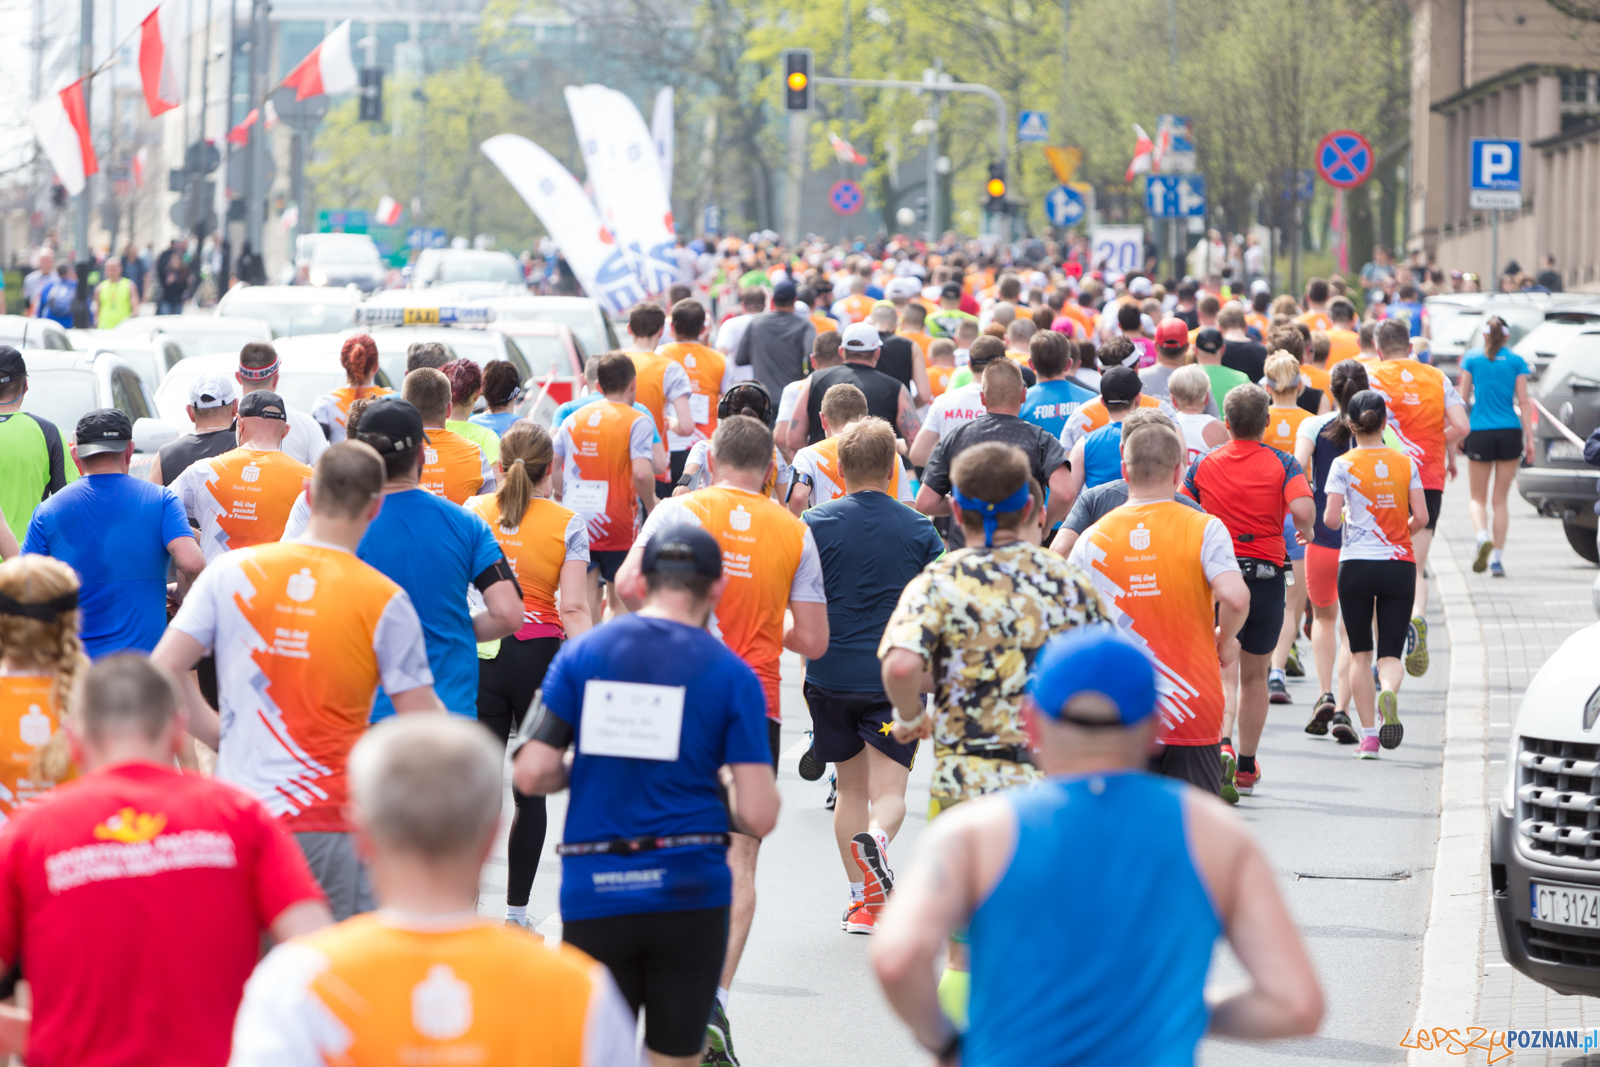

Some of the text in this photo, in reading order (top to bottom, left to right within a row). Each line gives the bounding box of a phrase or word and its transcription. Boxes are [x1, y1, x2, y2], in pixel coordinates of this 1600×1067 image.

[1481, 143, 1513, 186] P
[1099, 241, 1137, 276] 20
[1034, 404, 1055, 419] FOR
[1124, 552, 1158, 563] Bank Polski
[1129, 573, 1157, 583] Mój ślad
[1130, 581, 1157, 591] pozostał
[1133, 589, 1161, 598] Poznaniu
[1539, 888, 1600, 928] CT 3124
